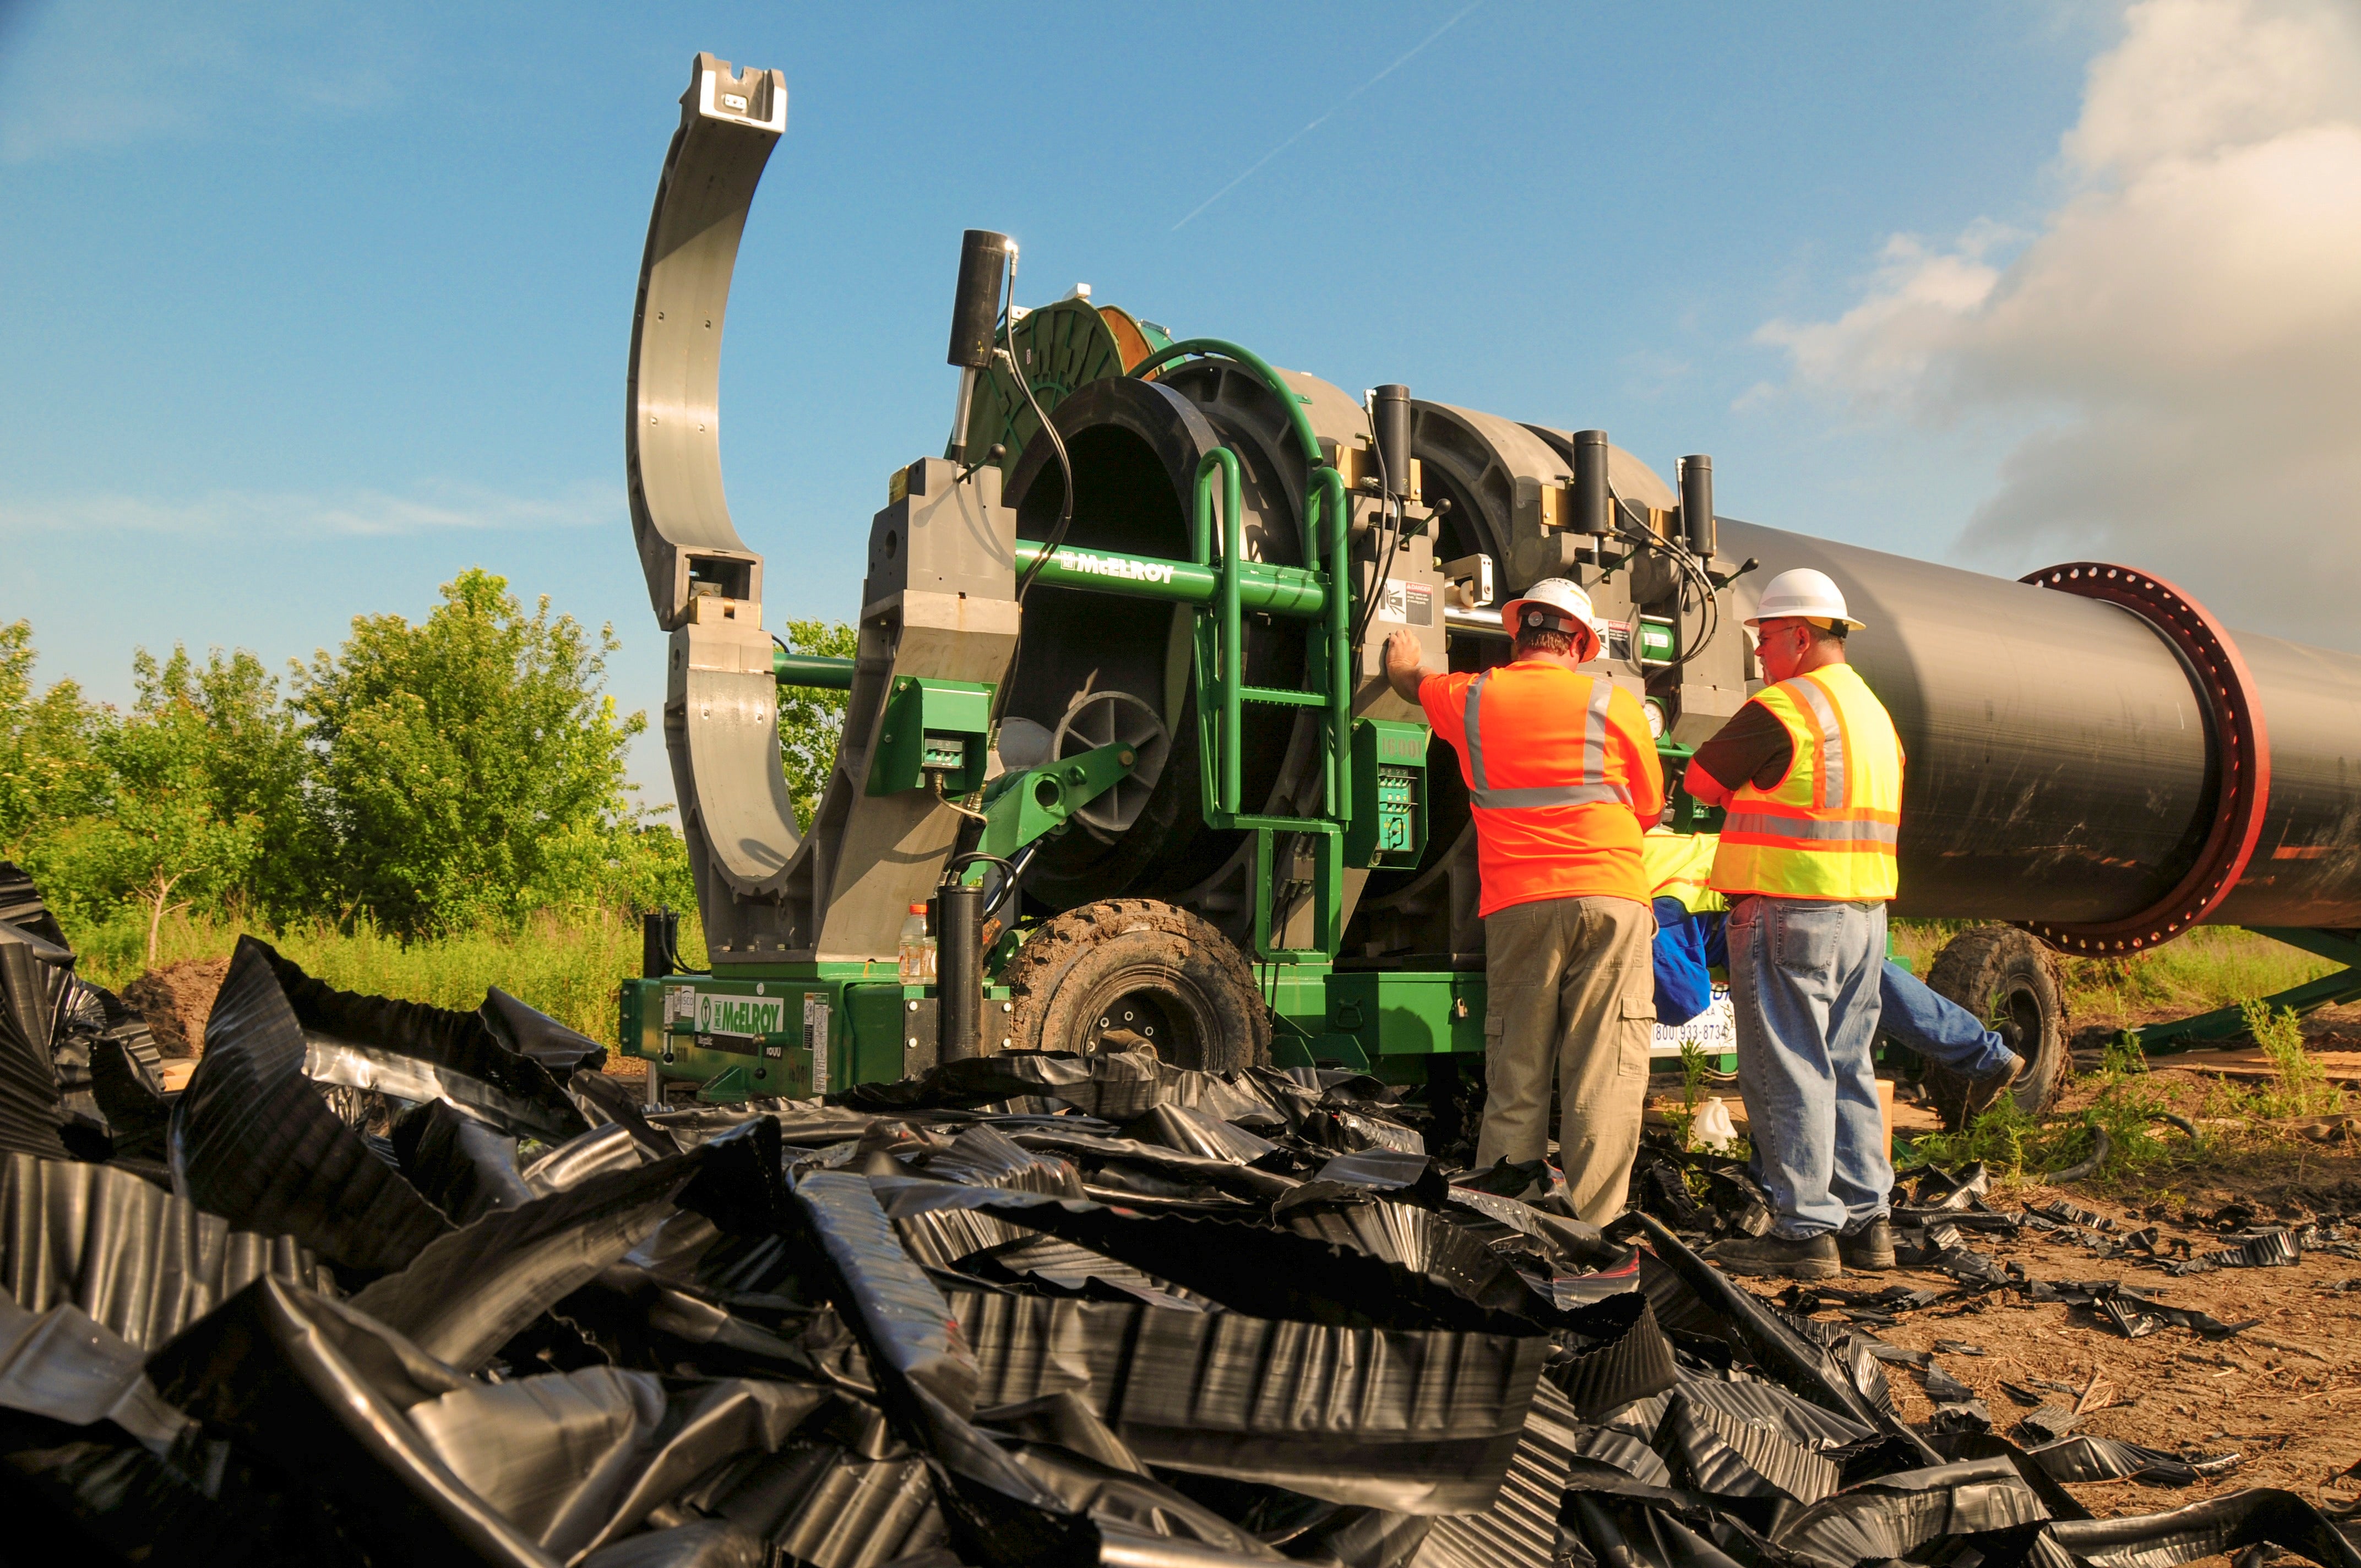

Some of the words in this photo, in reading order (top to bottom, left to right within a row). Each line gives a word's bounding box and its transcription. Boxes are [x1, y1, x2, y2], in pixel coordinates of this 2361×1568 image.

[1076, 553, 1174, 584] McELROY
[722, 1001, 780, 1034] McELROY
[1706, 1008, 1716, 1016] LA
[1653, 1025, 1678, 1041] (800)
